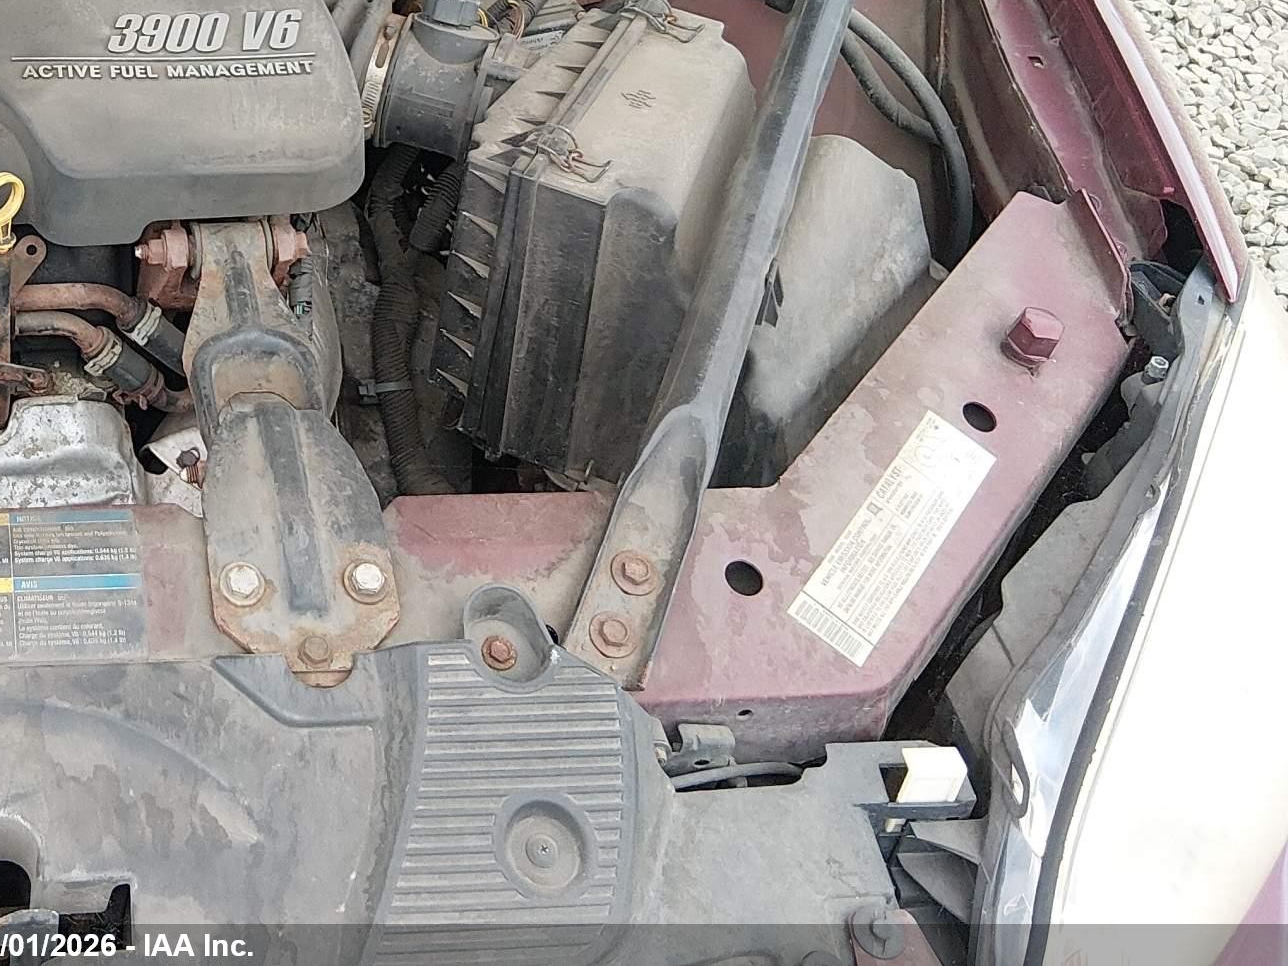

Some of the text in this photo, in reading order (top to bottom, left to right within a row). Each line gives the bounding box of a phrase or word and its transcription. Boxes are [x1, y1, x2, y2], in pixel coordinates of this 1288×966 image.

[108, 9, 302, 53] 3900 V6
[22, 60, 313, 80] ACTIVE FUEL MANAGEMENT
[875, 464, 903, 499] CATALYST
[21, 581, 38, 589] AVIS
